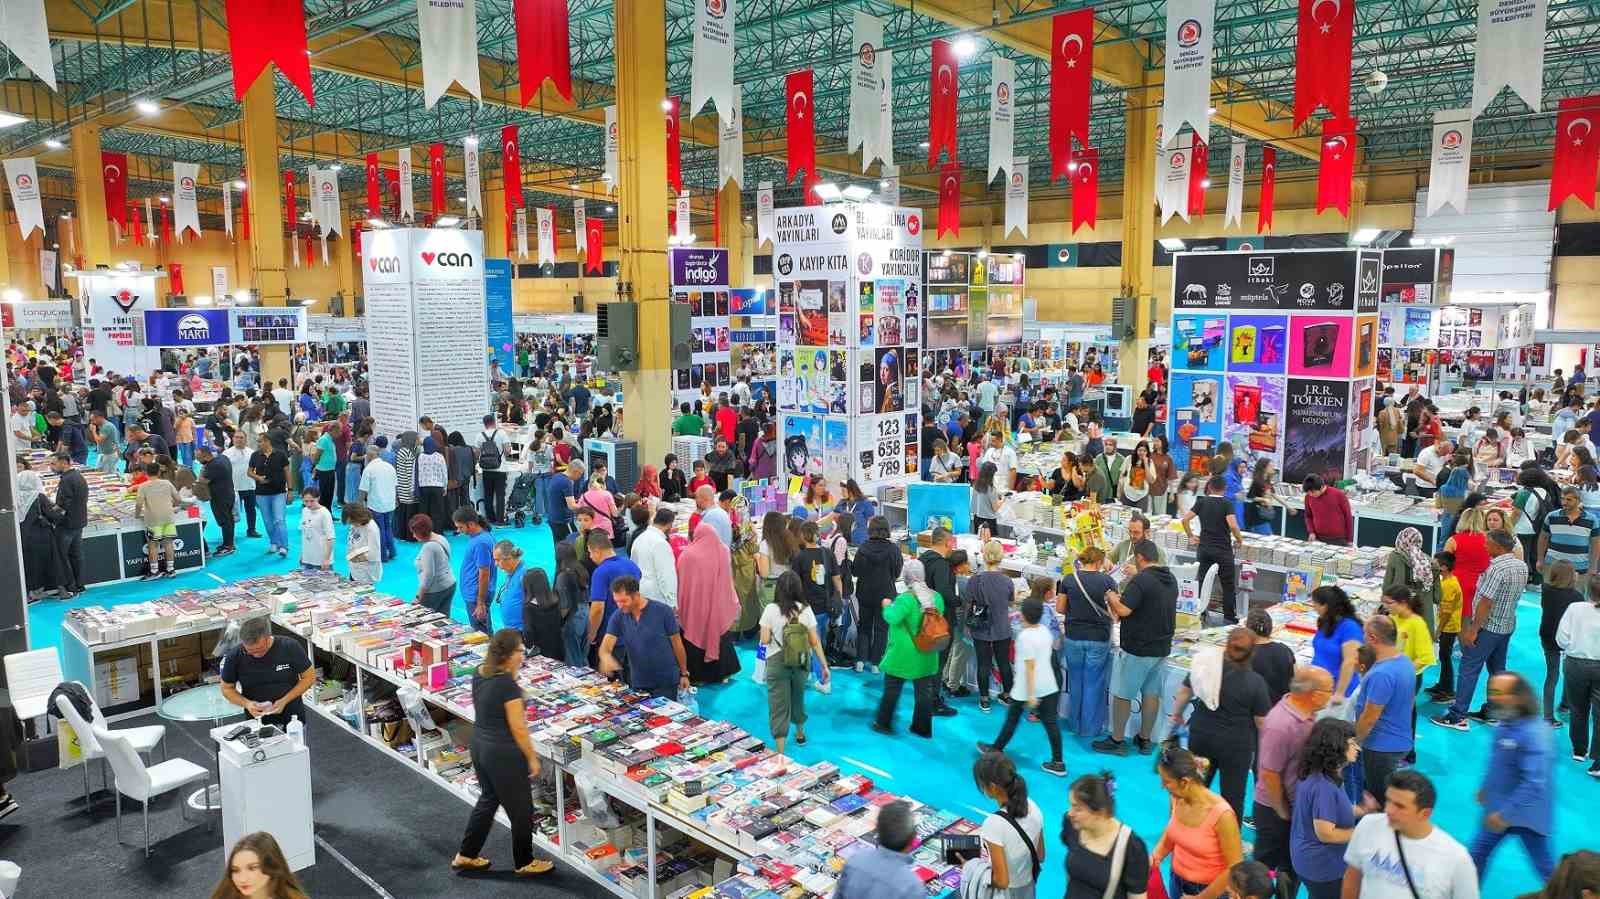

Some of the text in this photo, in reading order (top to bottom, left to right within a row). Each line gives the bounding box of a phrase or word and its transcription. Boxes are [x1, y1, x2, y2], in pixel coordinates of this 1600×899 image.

[777, 213, 815, 229] ARKADYA
[776, 228, 819, 243] YAYINLARI
[438, 252, 472, 267] can
[799, 256, 825, 272] KAYIP
[827, 254, 848, 270] KITA
[889, 248, 920, 264] KORİDOR
[378, 256, 400, 273] can
[881, 262, 920, 277] YAYINCILIK
[685, 266, 718, 284] indigo
[1304, 384, 1334, 397] J.R.R.
[1292, 394, 1345, 408] TOLKIEN
[788, 417, 795, 427] 4
[878, 419, 900, 437] 123
[878, 439, 901, 458] 658
[878, 458, 901, 478] 789
